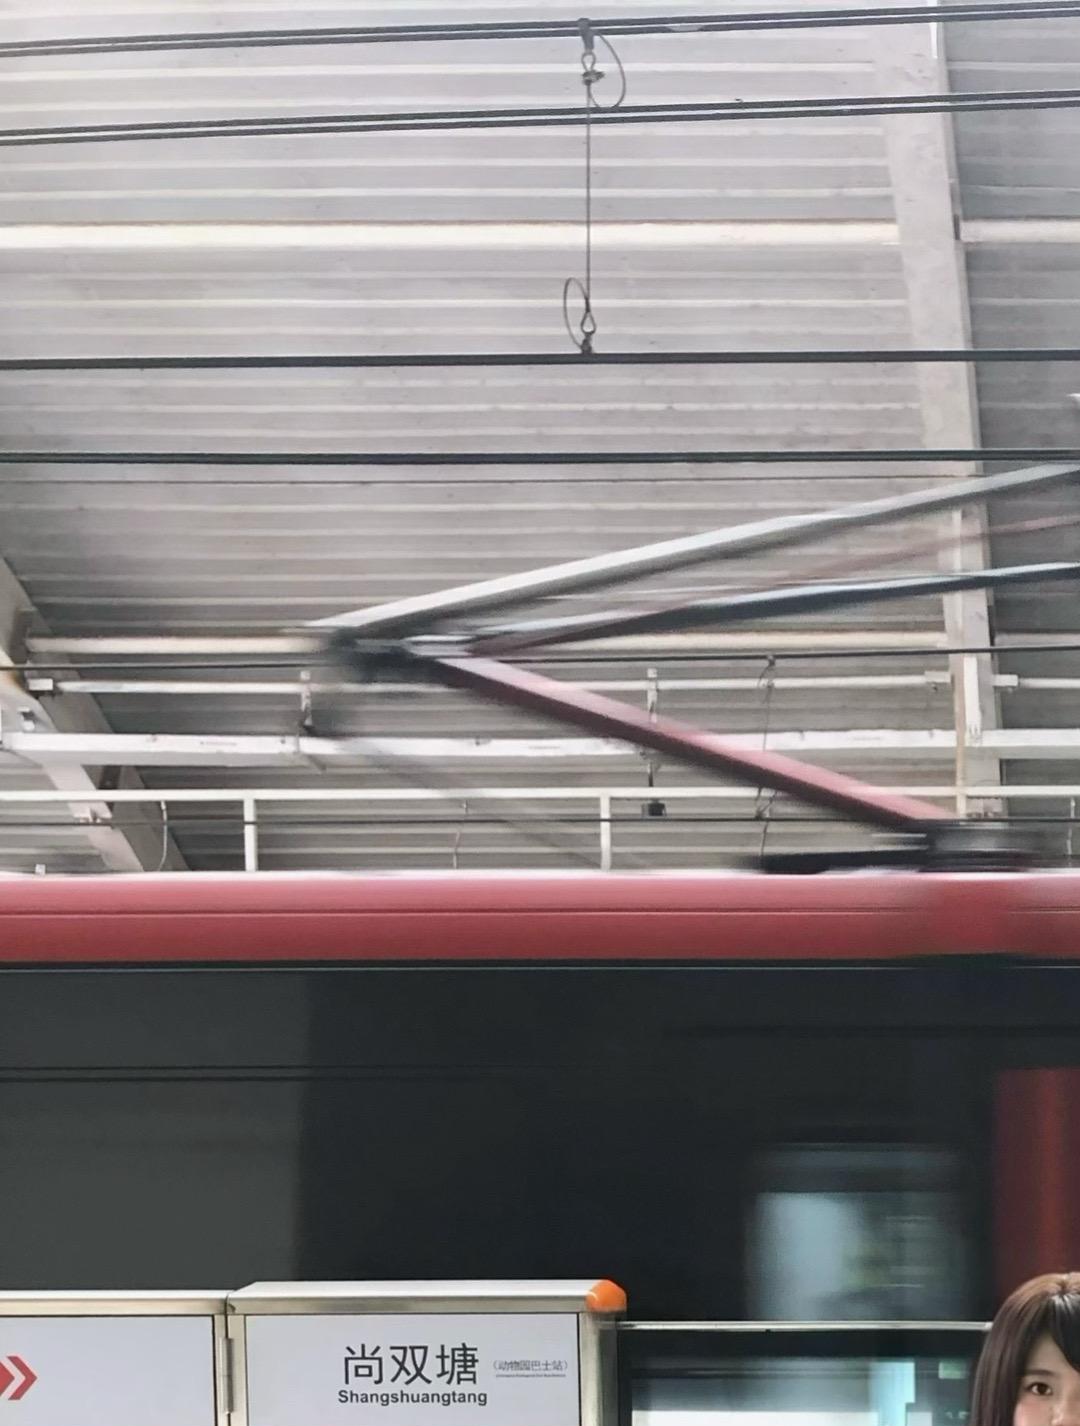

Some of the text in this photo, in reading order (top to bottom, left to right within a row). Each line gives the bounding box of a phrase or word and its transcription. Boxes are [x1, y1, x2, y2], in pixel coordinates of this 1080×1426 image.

[344, 1342, 479, 1385] 尚双塘
[338, 1389, 488, 1406] Shangshuangtang
